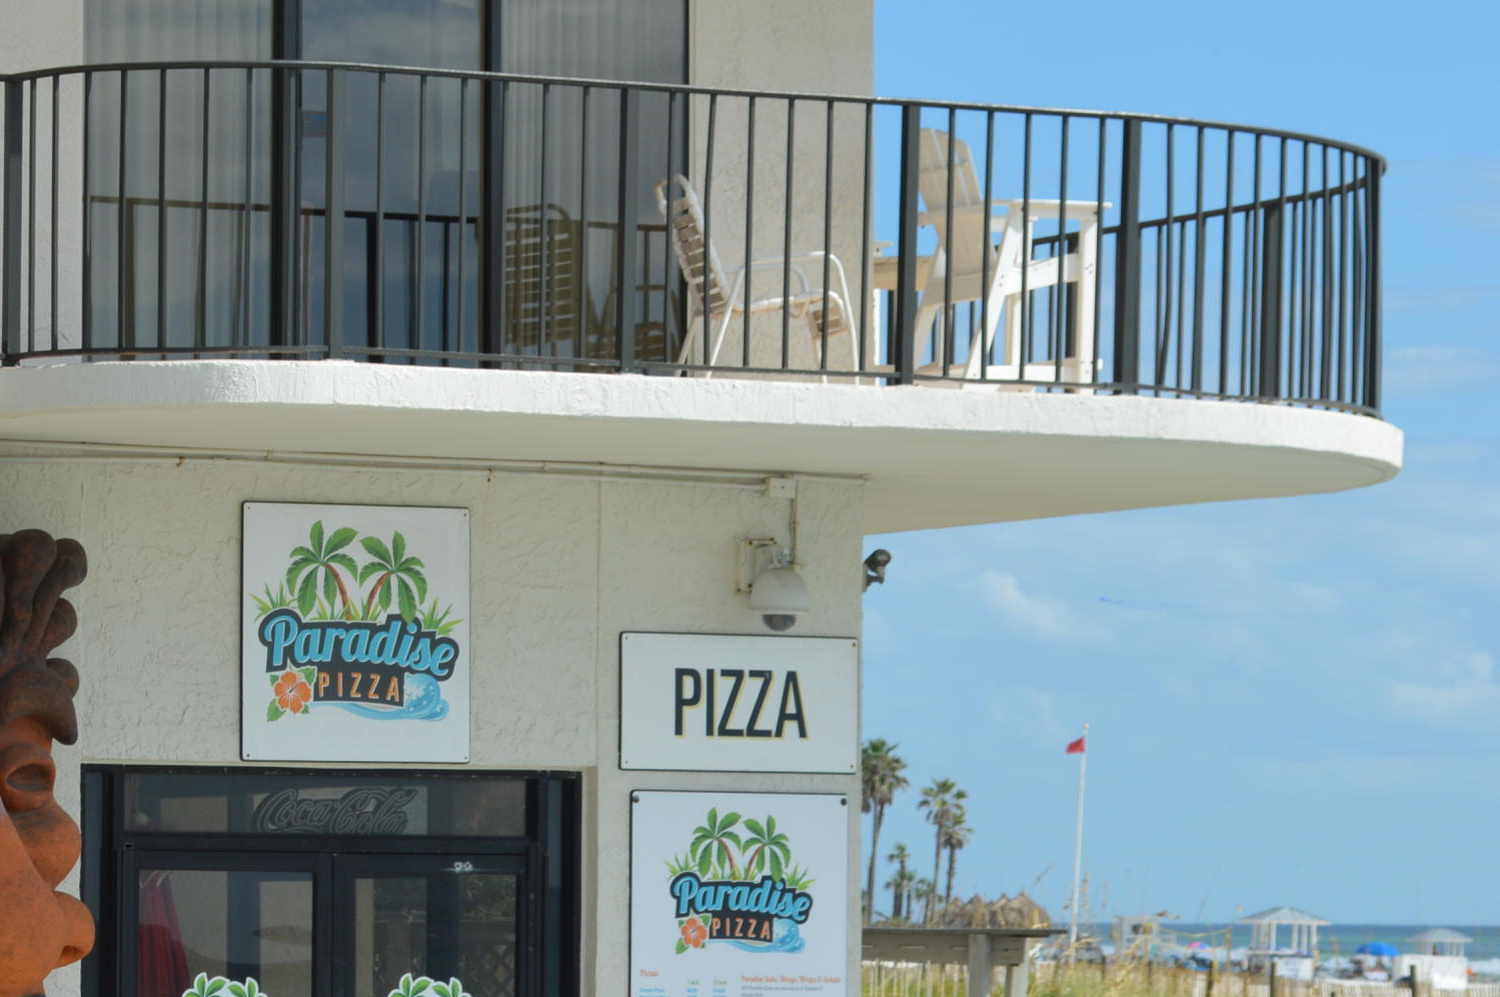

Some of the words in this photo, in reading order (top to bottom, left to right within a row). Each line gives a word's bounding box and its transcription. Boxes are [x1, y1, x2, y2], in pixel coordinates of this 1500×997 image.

[264, 614, 456, 676] Paradise
[317, 671, 400, 702] PIZZA
[674, 667, 808, 739] PIZZA
[673, 876, 811, 921] Paradise
[711, 917, 772, 940] PIZZA
